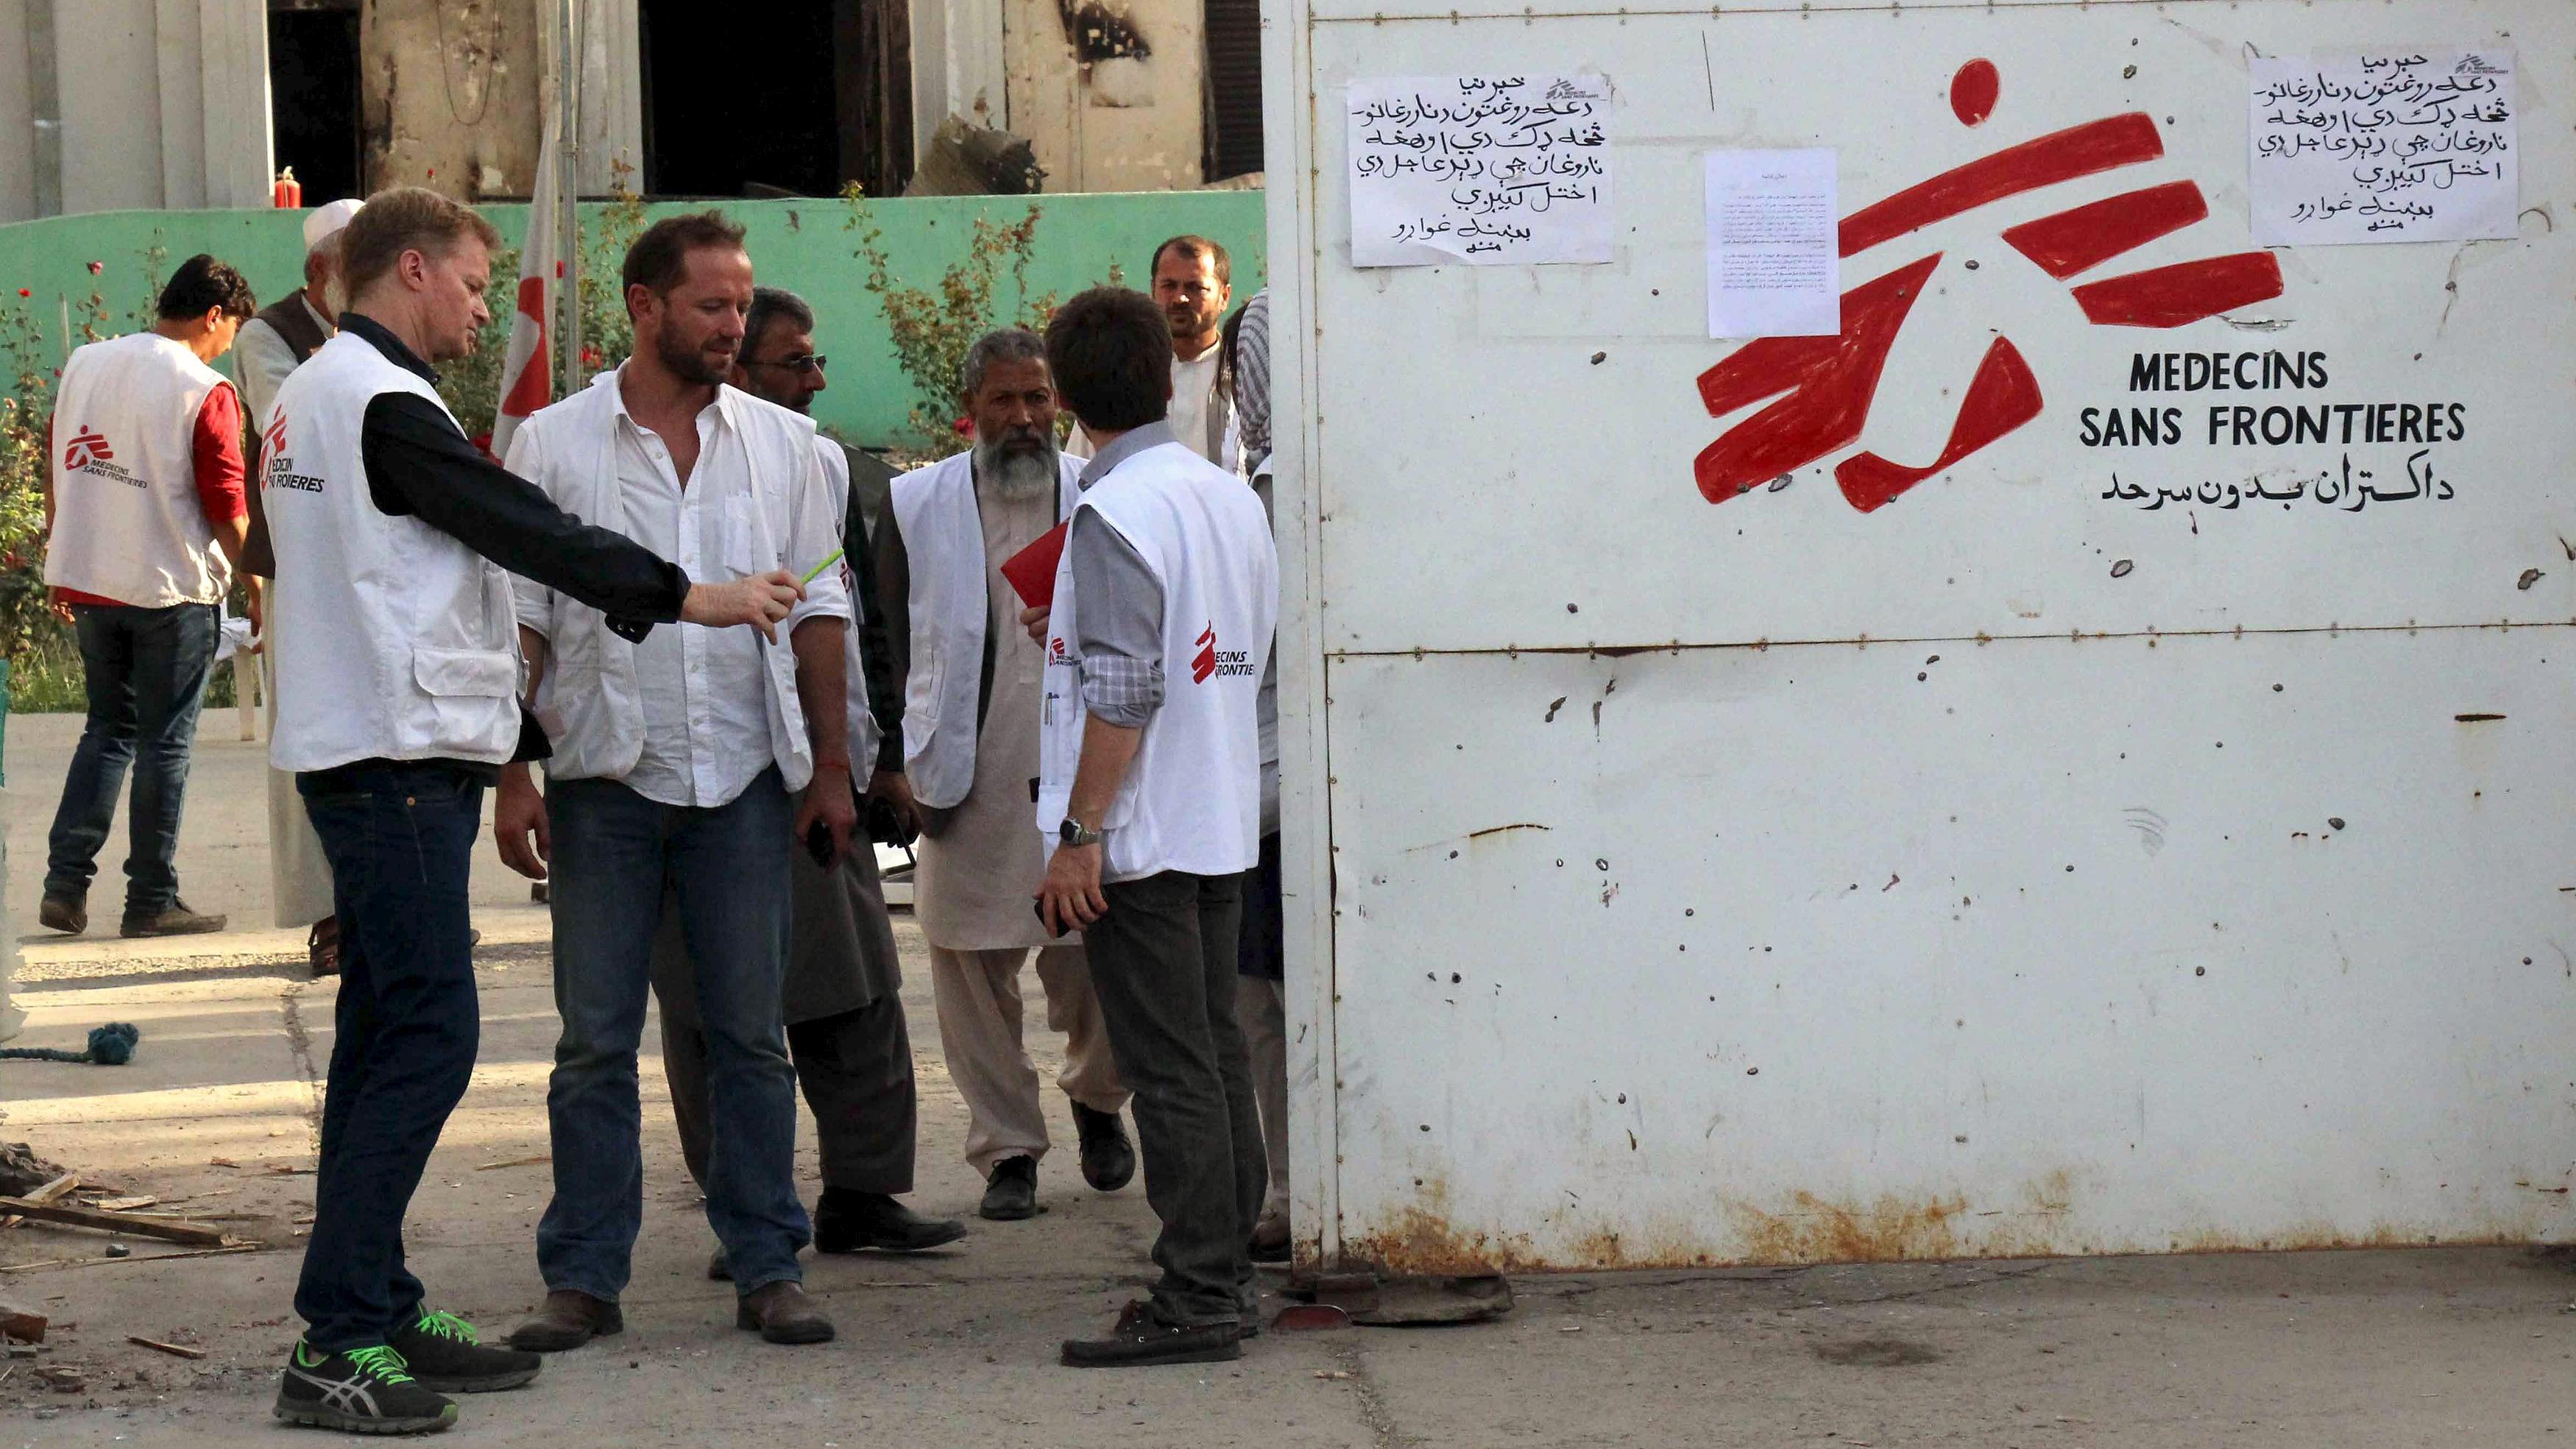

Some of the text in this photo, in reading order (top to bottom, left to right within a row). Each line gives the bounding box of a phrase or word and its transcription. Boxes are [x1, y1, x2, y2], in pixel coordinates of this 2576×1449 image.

[2354, 74, 2432, 106] روغتون
[1453, 96, 1530, 127] روغتون
[2284, 133, 2347, 157] عاجل
[1382, 155, 1444, 178] عاجل
[2129, 350, 2328, 392] MEDECINS
[2079, 403, 2466, 447] SANS FRONTIERES
[82, 465, 106, 476] SANS
[2102, 472, 2192, 510] سرحد
[2198, 471, 2305, 511] بدون
